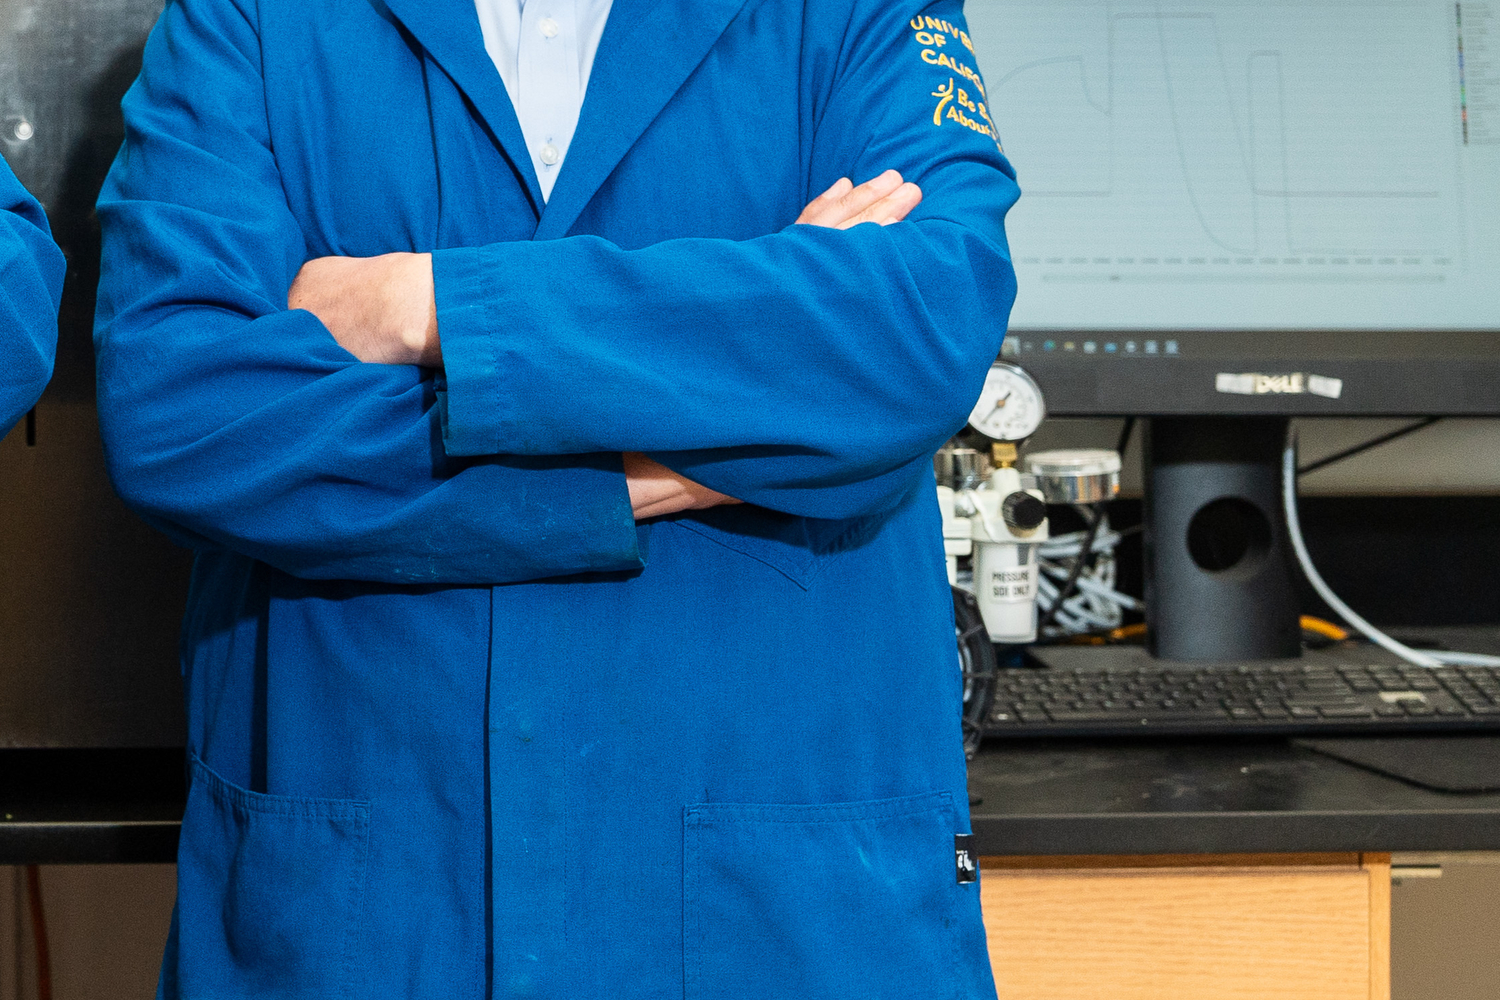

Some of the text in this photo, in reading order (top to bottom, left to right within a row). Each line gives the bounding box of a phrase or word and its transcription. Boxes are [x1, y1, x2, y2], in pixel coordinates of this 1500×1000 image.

[915, 31, 947, 47] OF
[957, 87, 977, 113] Be
[947, 106, 991, 135] About
[992, 570, 1030, 582] PRESSURE
